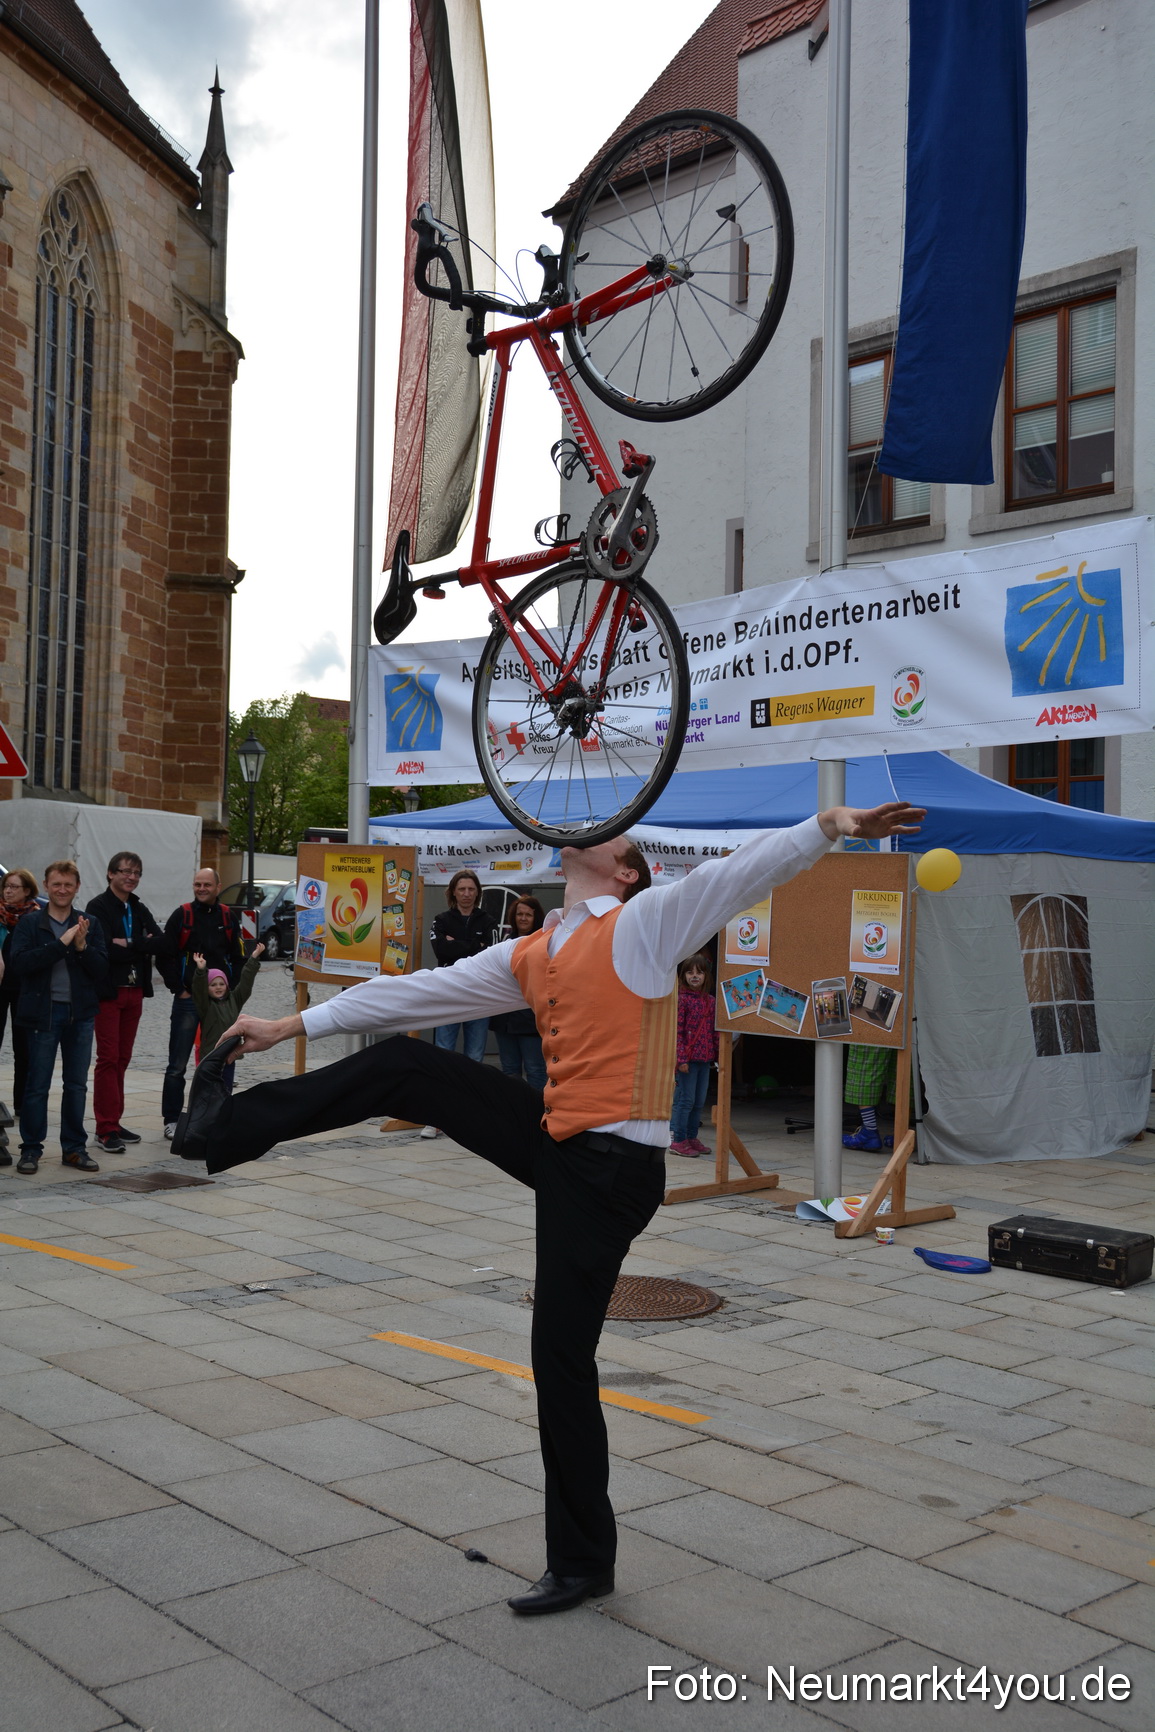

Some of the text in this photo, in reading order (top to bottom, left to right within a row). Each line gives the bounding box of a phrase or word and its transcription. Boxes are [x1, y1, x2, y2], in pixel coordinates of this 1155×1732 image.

[547, 370, 606, 481] SPECIALIZED
[497, 549, 549, 568] SPECIALIZED
[462, 583, 961, 683] Areitsgeminsaft ofene Behindertenarbeit
[656, 652, 756, 695] Nmarkt
[765, 638, 860, 674] i.d.OPf.
[775, 696, 865, 720] Regens Wagner
[604, 715, 631, 725] Caritas-
[655, 711, 741, 732] Nüerger Land
[657, 731, 705, 747] Narkt
[532, 744, 556, 755] Kreuz
[426, 844, 482, 857] Mit-Mach
[486, 839, 544, 855] Angebote
[701, 845, 729, 856] zu
[339, 856, 371, 865] WETTBEWERB
[331, 866, 375, 874] SYMPATHIEBLUME
[857, 893, 899, 903] URKUNDE
